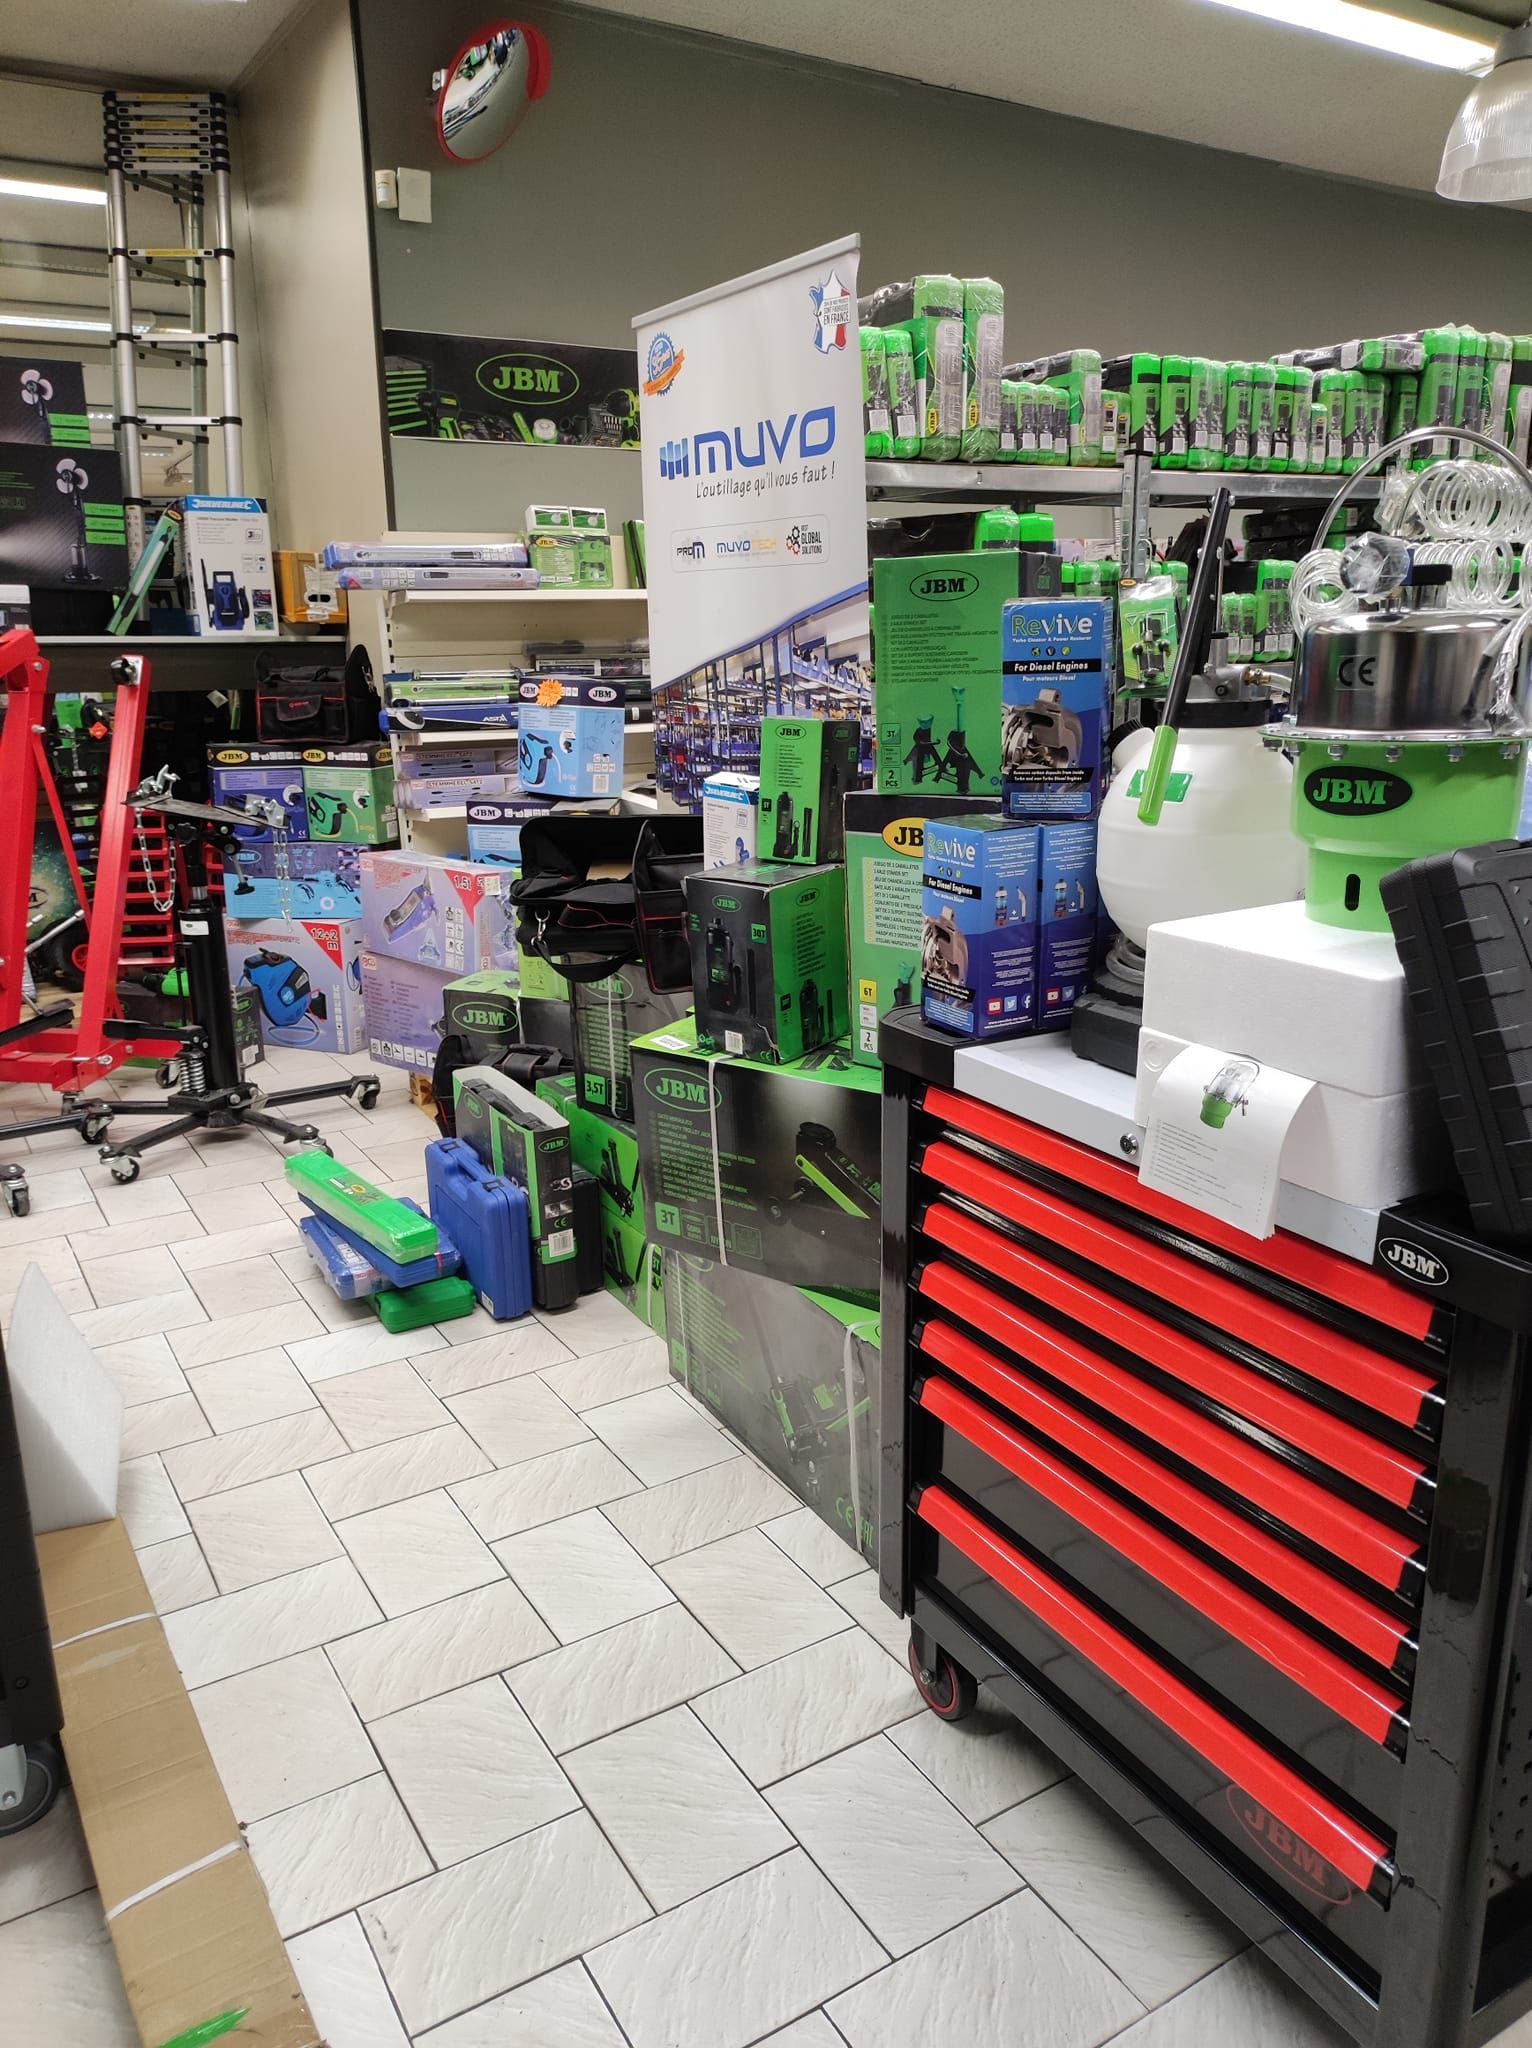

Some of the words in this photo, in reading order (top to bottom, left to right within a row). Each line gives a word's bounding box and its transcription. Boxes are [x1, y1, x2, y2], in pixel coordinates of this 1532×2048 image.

[824, 314, 830, 325] EN
[831, 311, 849, 324] FRANCE
[493, 366, 560, 393] JBM
[696, 478, 752, 498] L'outillage
[754, 471, 773, 496] qu'il
[775, 471, 798, 487] vous
[802, 464, 828, 484] faut
[801, 531, 822, 544] GLOBAL
[920, 578, 967, 595] JBM
[1011, 613, 1093, 637] Revive
[1014, 663, 1028, 672] For
[1029, 661, 1055, 672] Diesel
[1056, 661, 1089, 672] Engines
[1338, 657, 1377, 687] CE
[592, 690, 612, 698] JBM
[780, 728, 801, 737] JBM
[887, 730, 895, 738] 3T
[221, 752, 243, 760] JBM
[306, 751, 322, 759] JBM
[888, 770, 894, 779] 2
[1312, 777, 1387, 806] JBM
[473, 808, 497, 818] JBM
[893, 826, 924, 847] JB
[927, 832, 976, 861] Revive
[928, 877, 937, 885] For
[937, 880, 952, 890] Diesel
[952, 883, 973, 895] Engines
[716, 897, 736, 909] JBM
[752, 928, 766, 938] 30T
[864, 987, 873, 997] 6T
[463, 1010, 506, 1027] JBM
[866, 1032, 871, 1042] 2
[863, 1043, 873, 1051] PCS
[586, 1080, 604, 1096] 3,5T
[656, 1077, 707, 1105] JBM
[544, 1138, 564, 1150] JBM
[554, 1217, 568, 1229] CE
[660, 1210, 675, 1225] 3T
[1387, 1243, 1436, 1279] JBM
[1244, 1805, 1327, 1887] JBM
